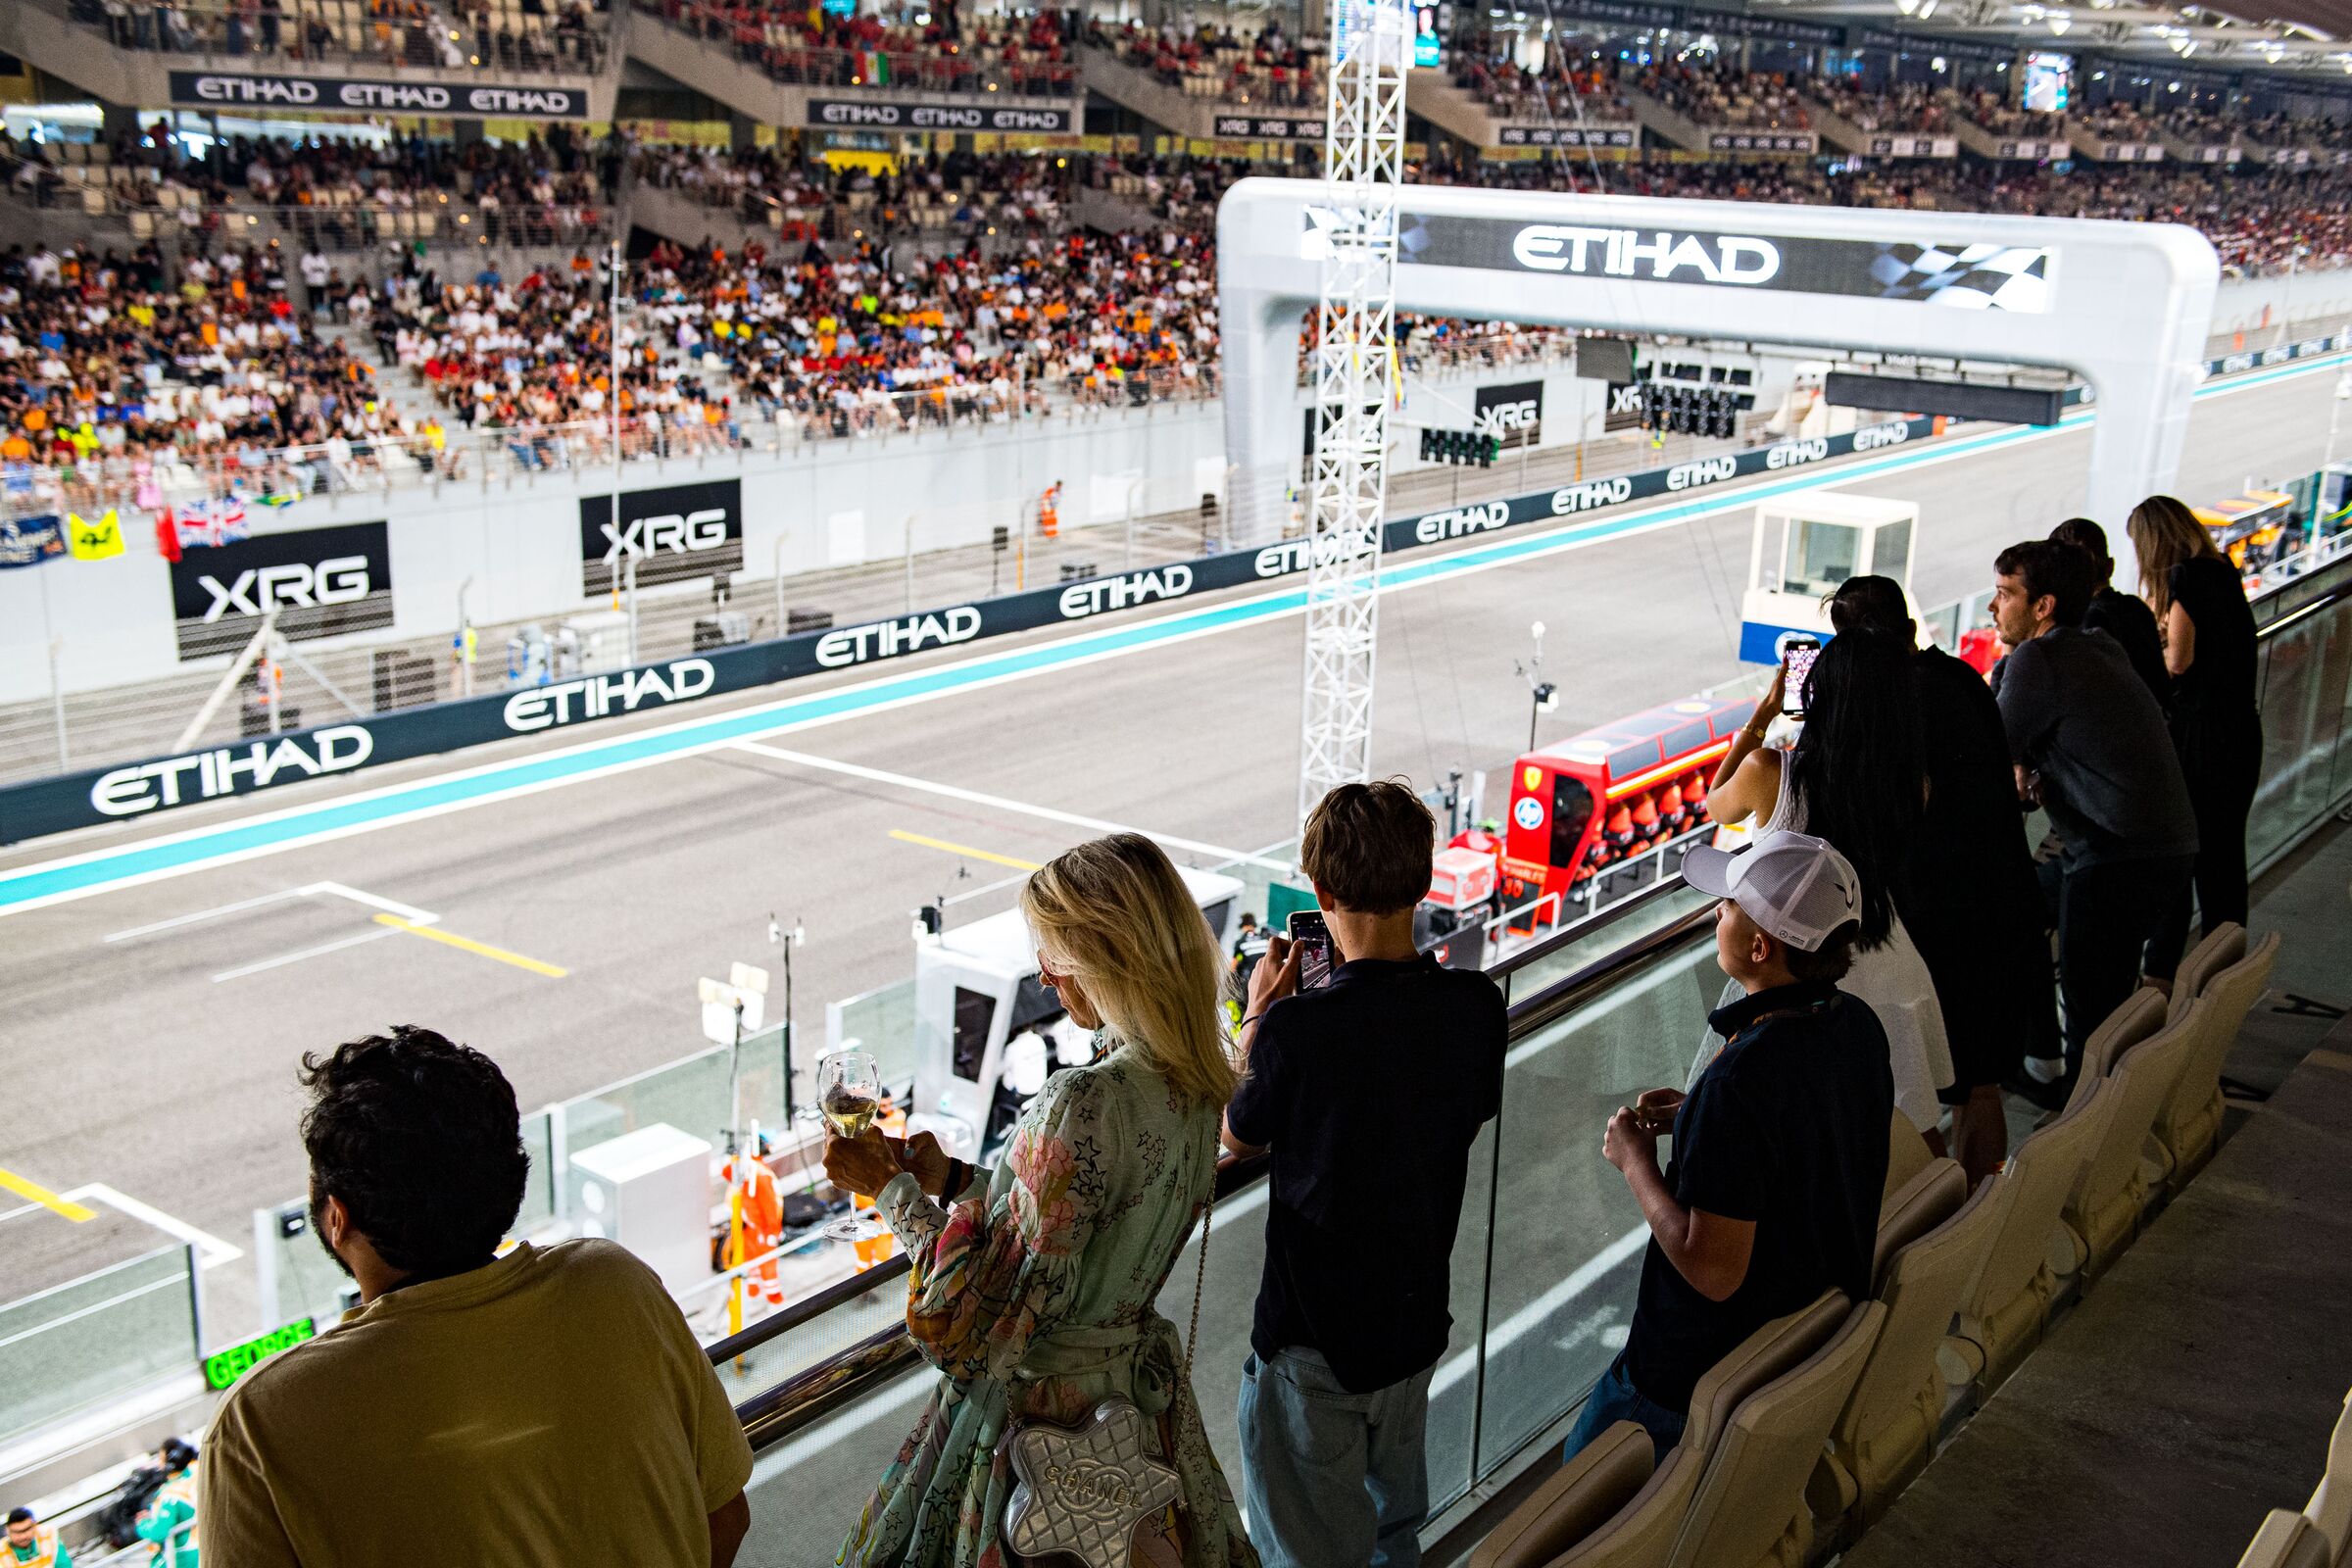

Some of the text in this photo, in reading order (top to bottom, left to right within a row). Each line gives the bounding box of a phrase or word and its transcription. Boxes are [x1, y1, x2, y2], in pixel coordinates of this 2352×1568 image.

[196, 77, 571, 114] ETIHAD ETIHAD ETIHAD
[822, 104, 1059, 129] ETIHAD ETIHAD ETIHAD
[1513, 224, 1781, 284] ETIHAD
[1479, 400, 1538, 434] XRG
[600, 509, 726, 565] XRG
[198, 555, 369, 623] XRG
[90, 725, 373, 815] ETIHAD
[504, 659, 714, 731] ETIHAD
[815, 606, 981, 667] ETIHAD
[1059, 564, 1193, 618] ETIHAD
[1416, 501, 1509, 543] ETIHAD
[1551, 477, 1632, 514] ETIHAD
[1667, 456, 1737, 490] ETIHAD
[1767, 438, 1828, 469] ETIHAD
[1853, 421, 1909, 452] ETIHAD
[207, 1317, 314, 1390] GEORGE
[1045, 1466, 1143, 1509] CHANEL
